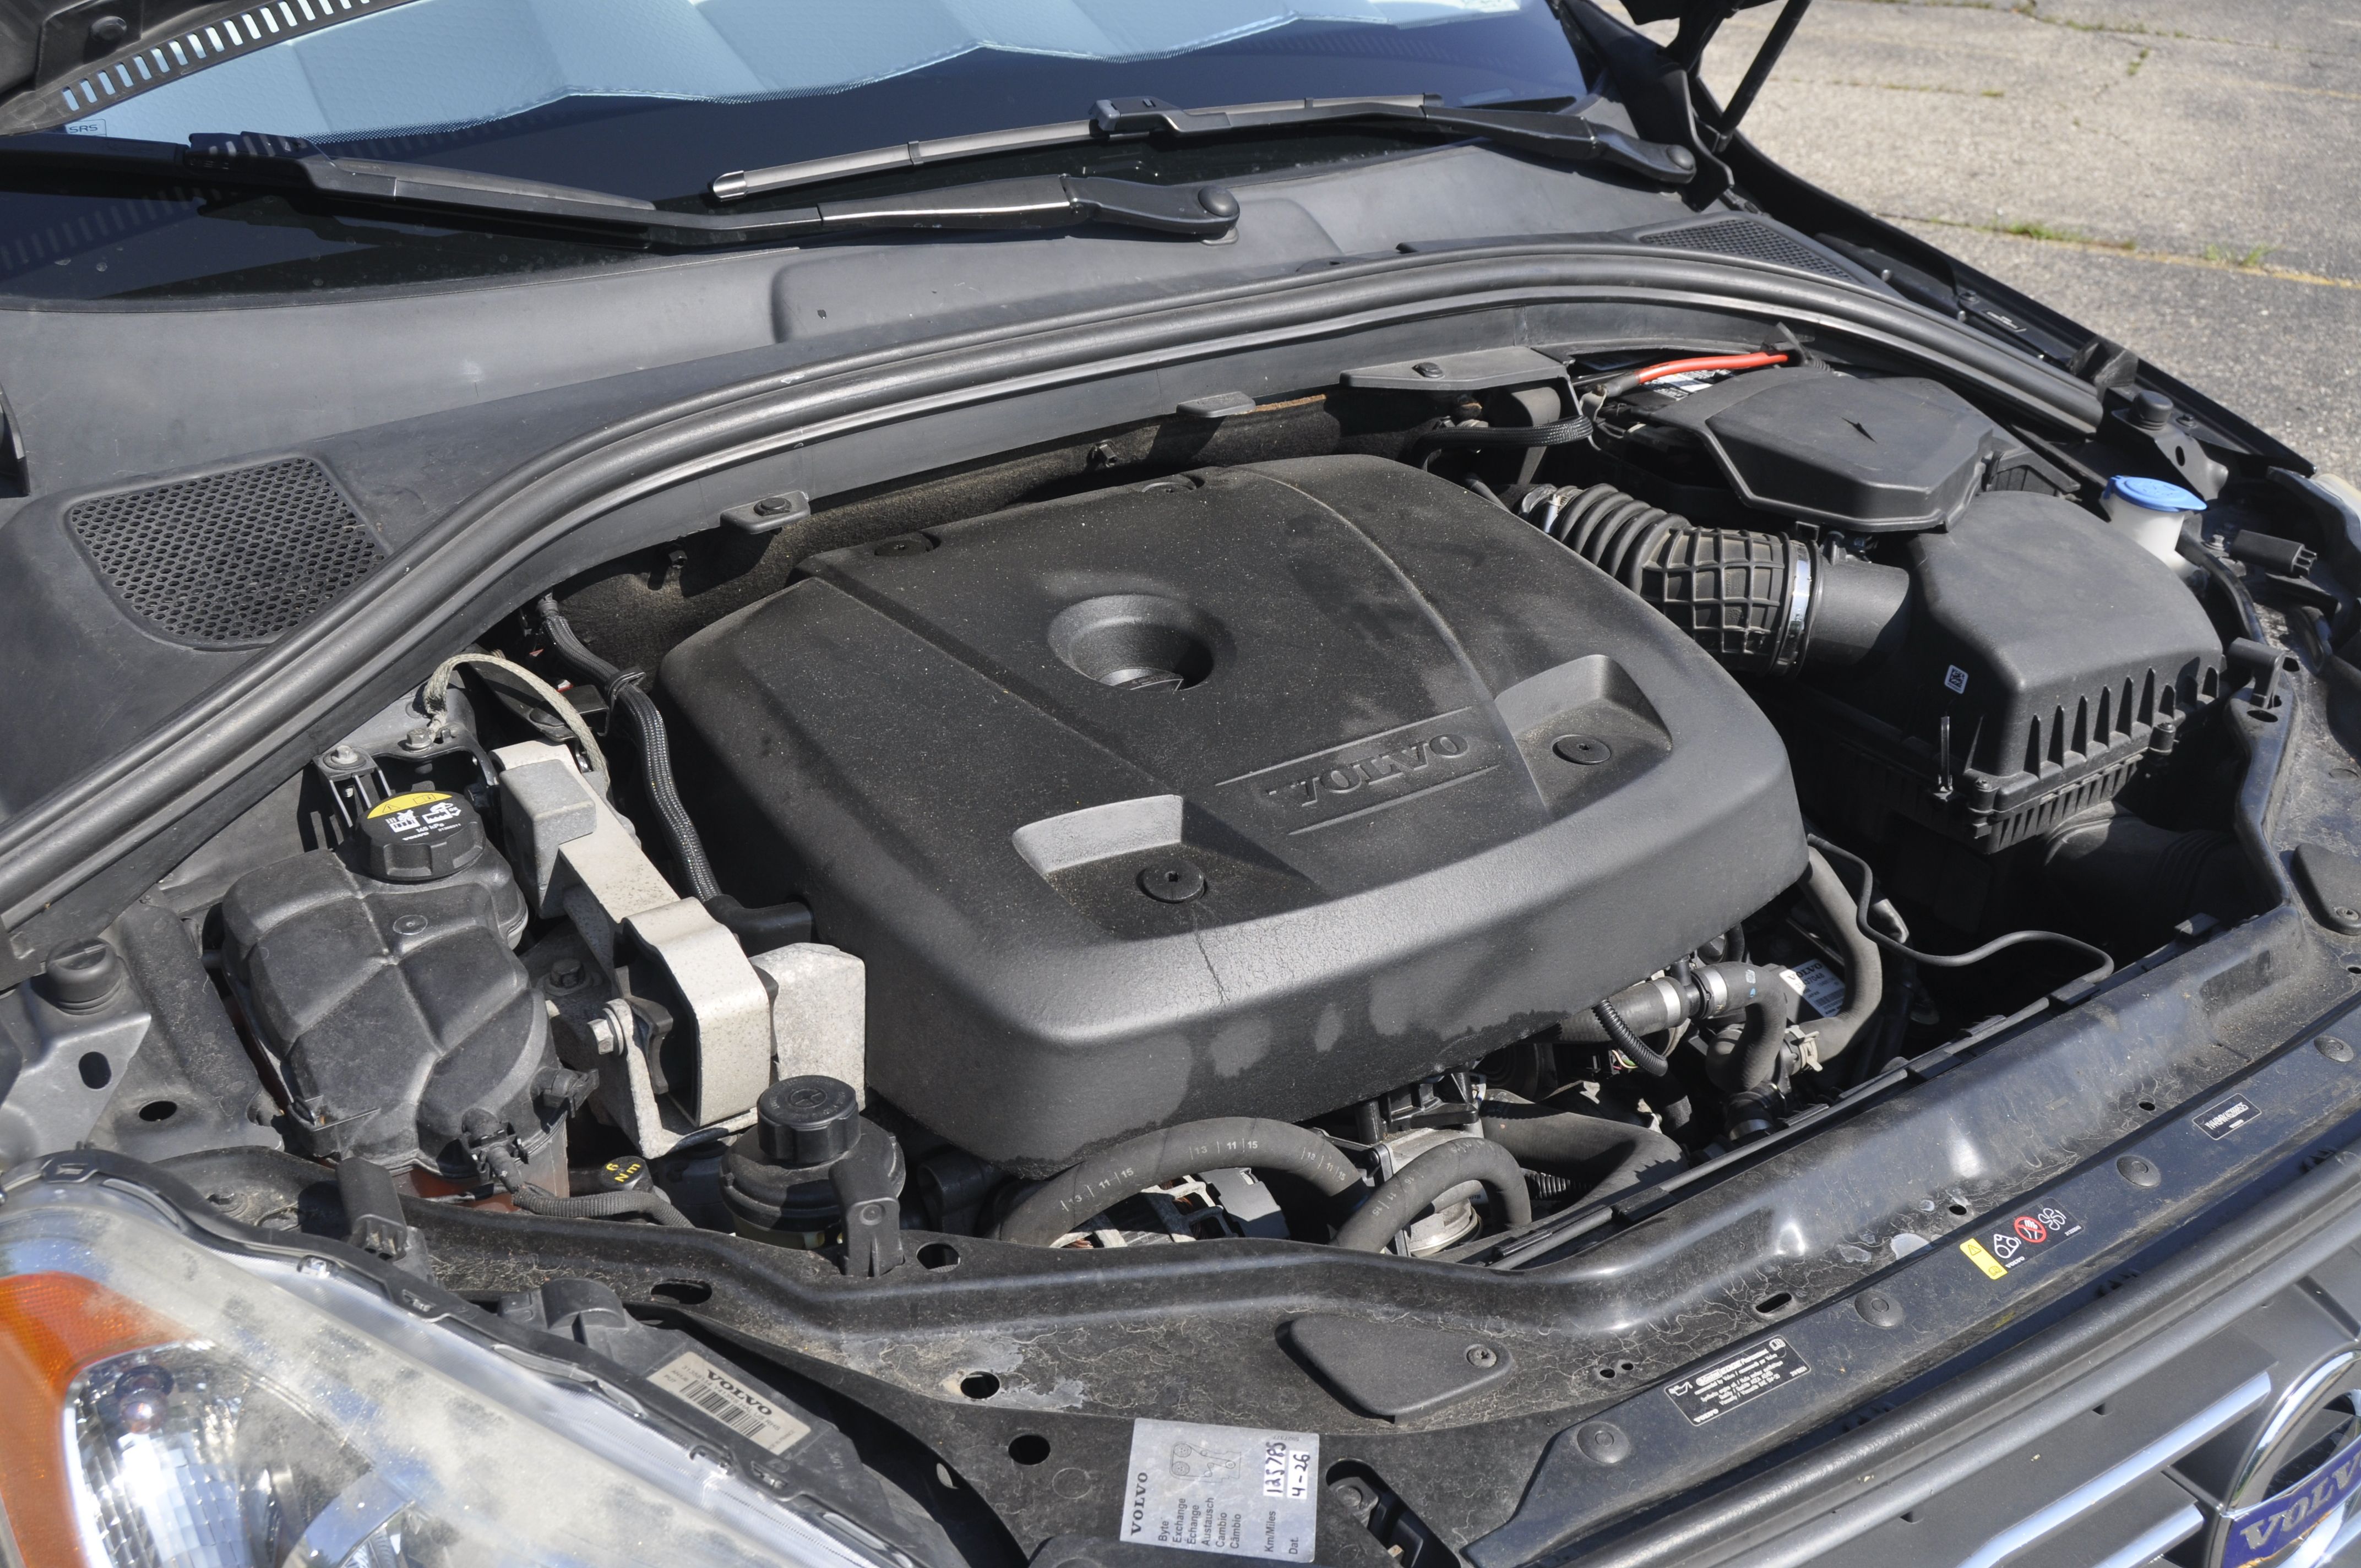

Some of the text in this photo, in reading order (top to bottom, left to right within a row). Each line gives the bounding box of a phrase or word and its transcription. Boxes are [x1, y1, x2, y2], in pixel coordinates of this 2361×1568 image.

[69, 124, 98, 134] SRS
[1267, 733, 1469, 807] VOLVO
[1787, 963, 1823, 980] VOLVO
[1194, 1141, 1258, 1155] 13 11 15
[614, 1163, 641, 1183] Nm
[1098, 1179, 1111, 1189] 11
[1121, 1168, 1134, 1178] 15
[1339, 1171, 1346, 1181] 15
[1372, 1206, 1383, 1216] 15
[2005, 1256, 2025, 1268] VOLVO
[707, 1369, 772, 1415] VOLVO
[1694, 1408, 1718, 1422] VOLVO
[1131, 1472, 1148, 1536] VOLVO
[2240, 1451, 2361, 1549] VOLV
[1158, 1520, 1169, 1542] Byte
[1173, 1498, 1187, 1543] Exchange
[1187, 1505, 1201, 1544] Échange
[1201, 1497, 1215, 1546] Austausch
[1216, 1512, 1227, 1548] Cambio
[1230, 1513, 1242, 1549] Câmbio
[1264, 1511, 1276, 1552] Km/Miles
[1289, 1537, 1299, 1555] Dat.
